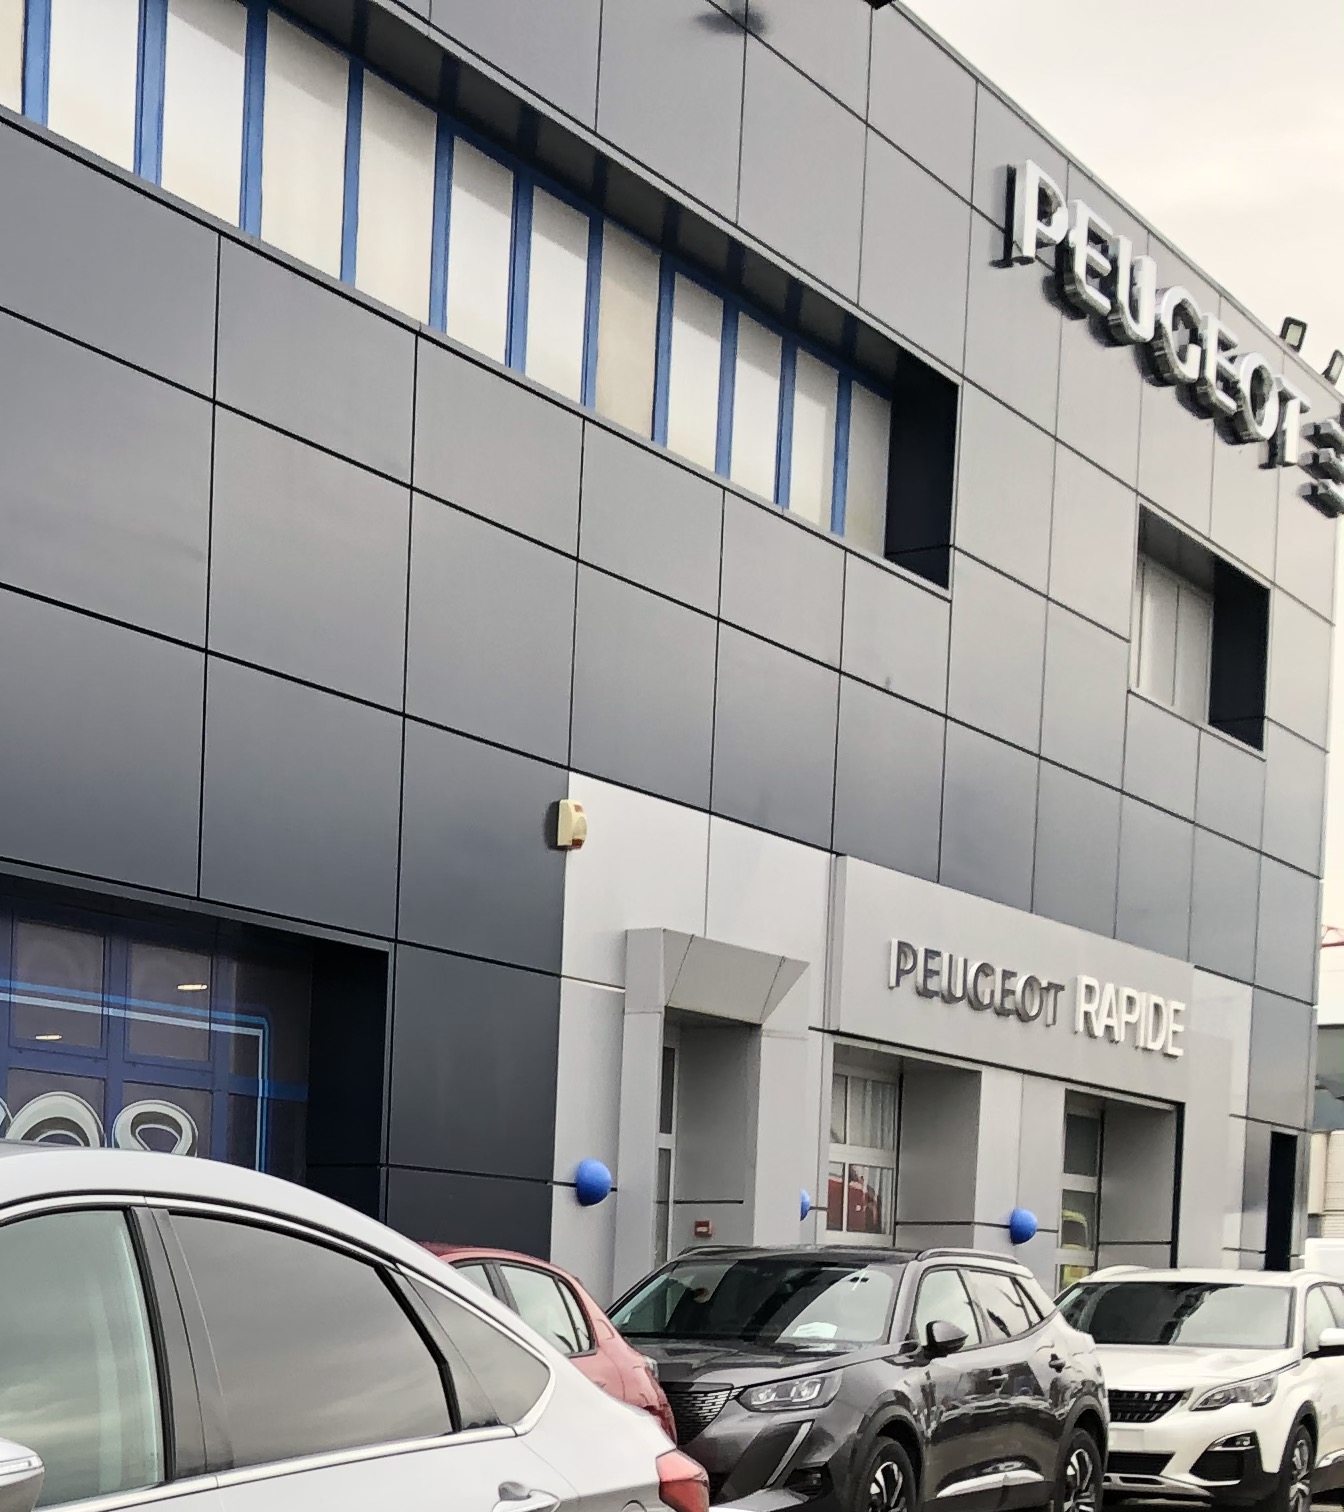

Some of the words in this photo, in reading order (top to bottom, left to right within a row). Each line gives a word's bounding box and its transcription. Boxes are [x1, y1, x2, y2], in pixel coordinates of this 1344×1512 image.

[1013, 159, 1310, 466] PEUGEOT
[888, 938, 1065, 1027] PEUGEOT
[1074, 974, 1186, 1058] RAPIDE
